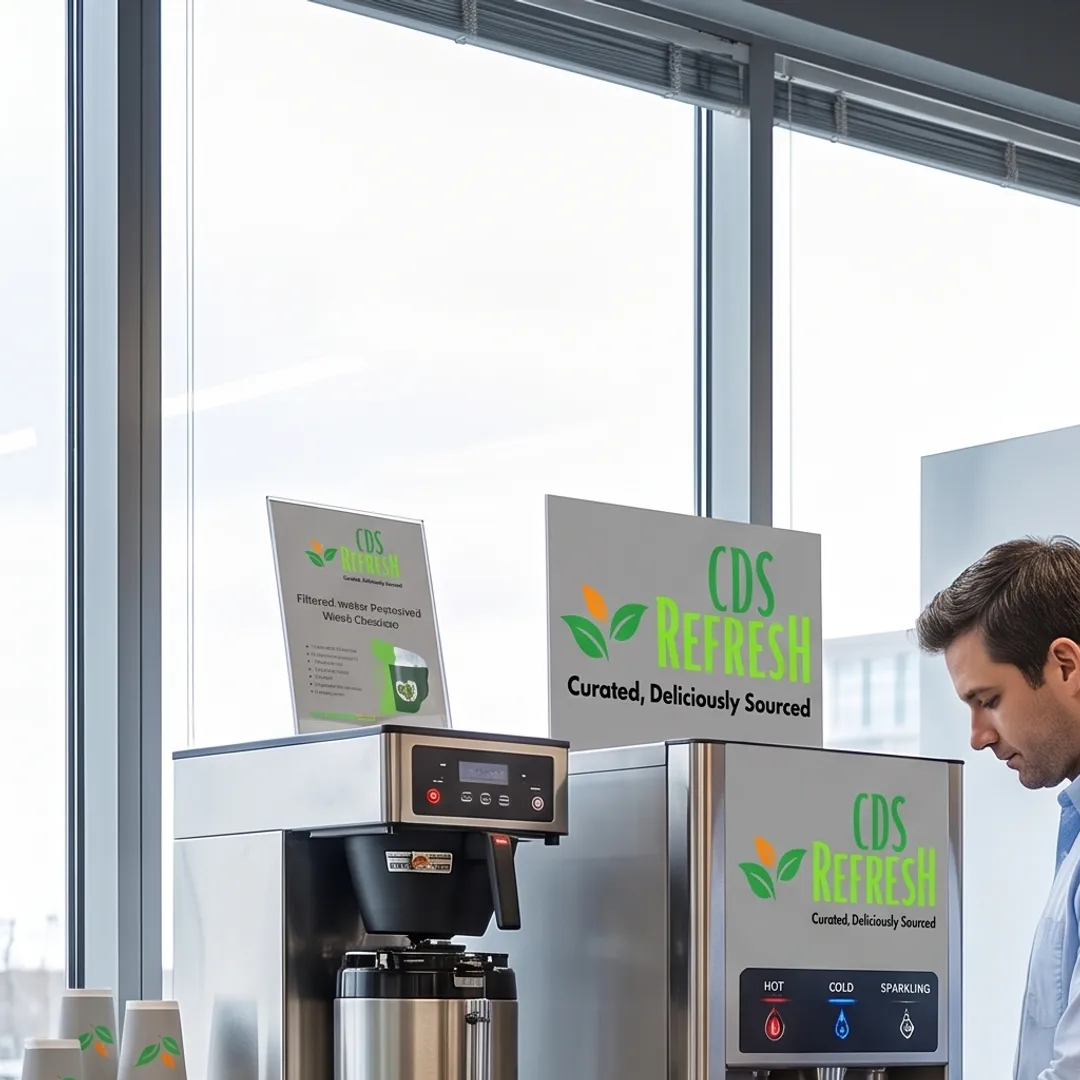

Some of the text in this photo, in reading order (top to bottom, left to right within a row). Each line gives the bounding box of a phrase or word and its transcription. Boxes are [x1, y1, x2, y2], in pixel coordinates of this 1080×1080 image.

[356, 528, 384, 555] CDS
[708, 545, 775, 618] CDS
[656, 595, 812, 685] REFRESH
[567, 675, 811, 718] Curated, Deliciously Sourced
[853, 793, 907, 853] CDS
[812, 841, 936, 907] REFRESH
[811, 912, 936, 931] Curated, Deliciously Sourced
[764, 981, 931, 995] HOT COLD SPARKLING
